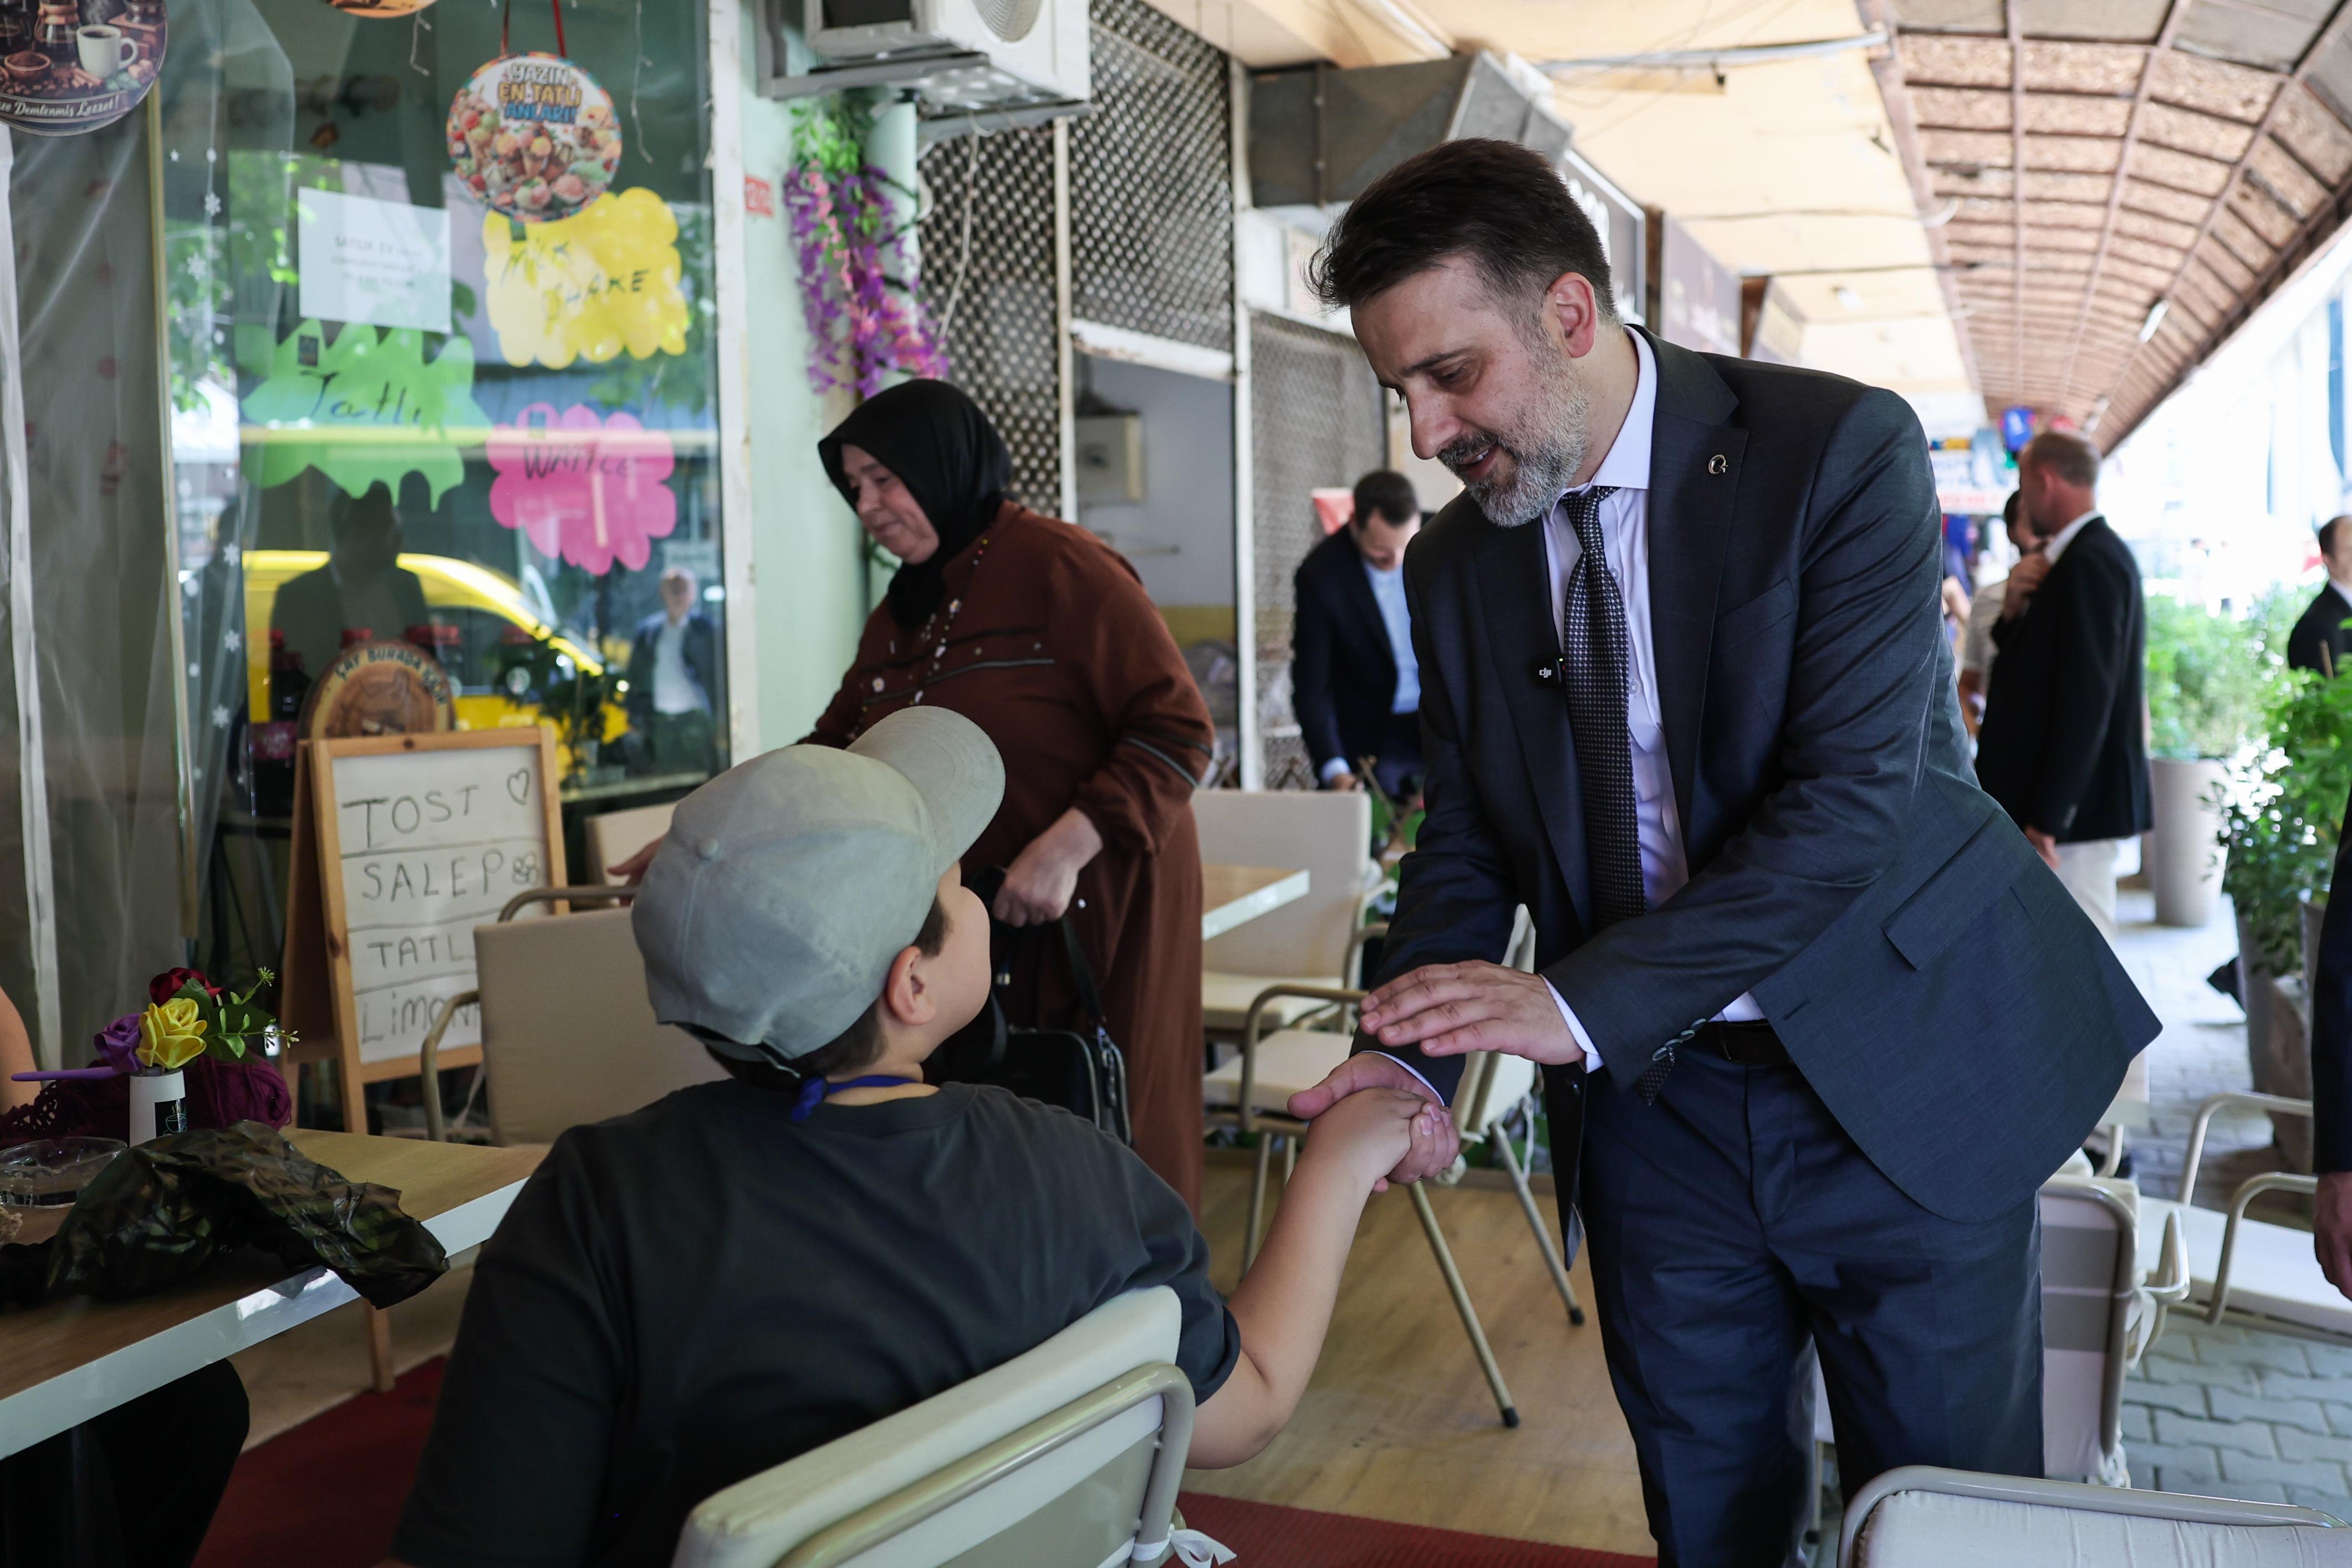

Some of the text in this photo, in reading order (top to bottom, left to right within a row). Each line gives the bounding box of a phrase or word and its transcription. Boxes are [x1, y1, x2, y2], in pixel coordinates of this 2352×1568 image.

[499, 82, 524, 101] EN
[341, 784, 480, 849] TOST
[362, 848, 504, 902] SALEP
[366, 933, 477, 968] TATL
